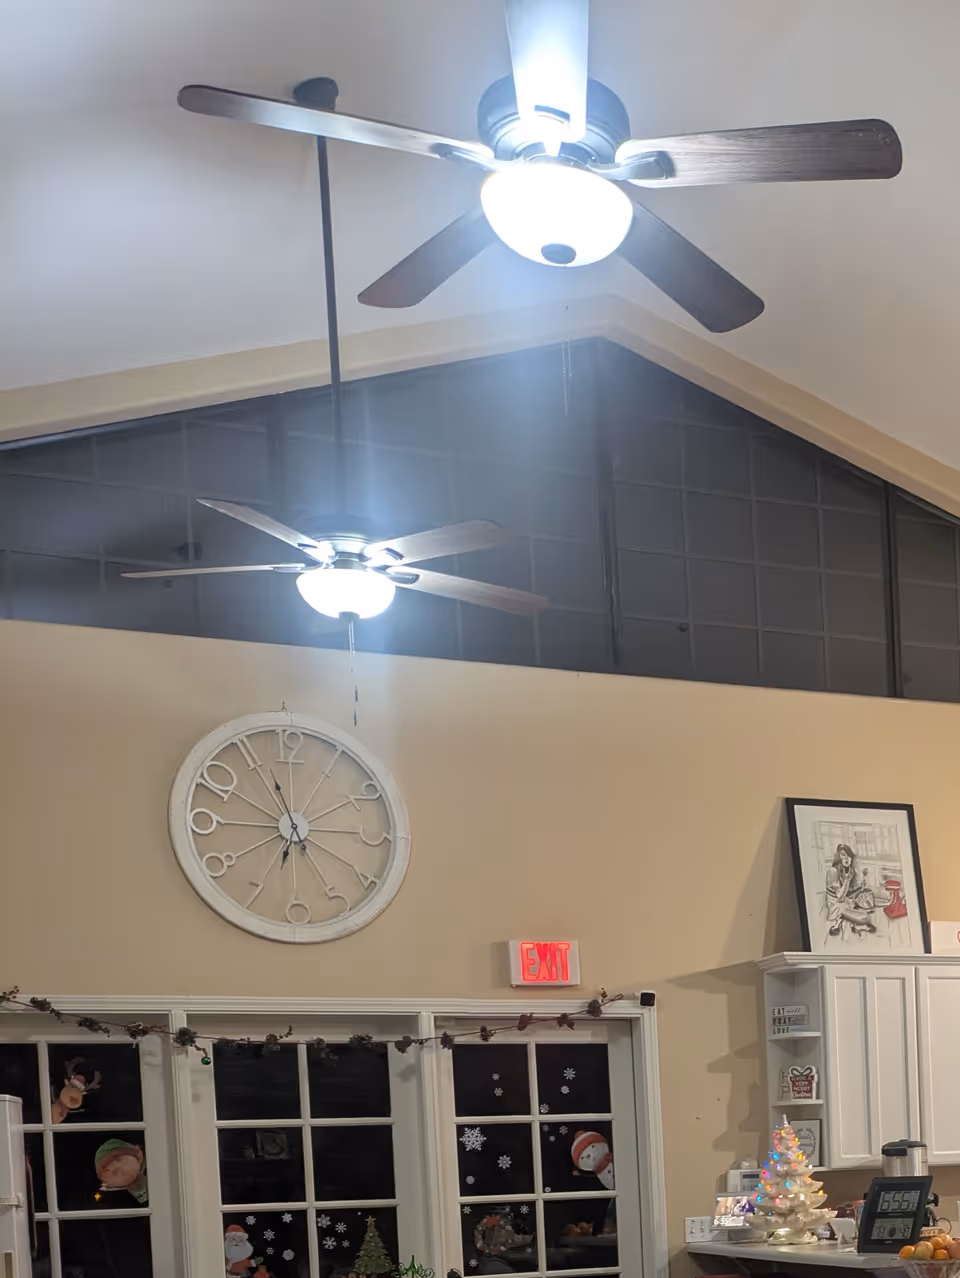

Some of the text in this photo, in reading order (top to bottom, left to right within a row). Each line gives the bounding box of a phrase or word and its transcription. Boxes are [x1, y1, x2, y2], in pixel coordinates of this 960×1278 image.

[232, 735, 263, 771] 11
[275, 729, 304, 764] 12
[196, 761, 237, 802] 10
[189, 807, 225, 835] 9
[202, 852, 237, 878] 8
[520, 942, 571, 982] EXIT
[772, 1007, 785, 1016] EAT
